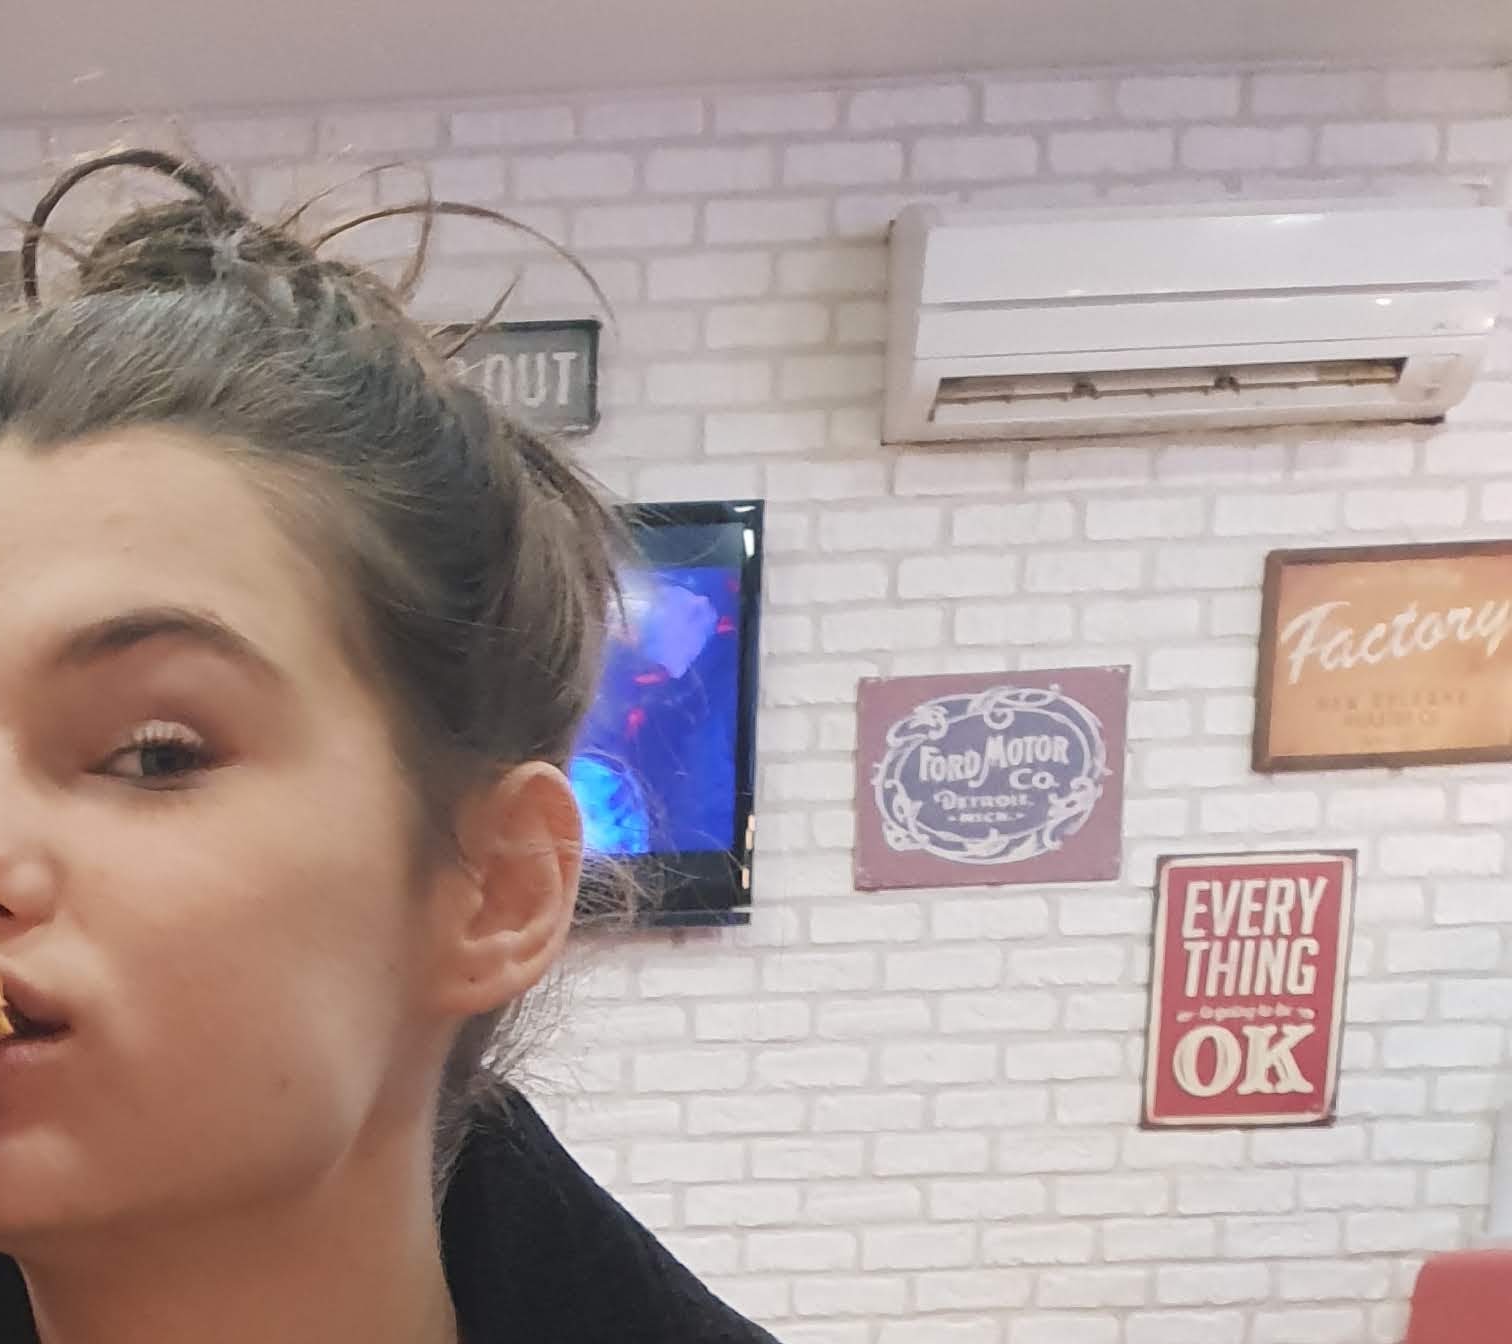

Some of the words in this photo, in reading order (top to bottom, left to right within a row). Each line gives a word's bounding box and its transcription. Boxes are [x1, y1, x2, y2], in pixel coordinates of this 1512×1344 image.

[484, 351, 579, 407] OUT
[1280, 599, 1511, 685] Factory
[982, 735, 1070, 772] MOTOR
[1182, 876, 1328, 938] EVERY
[1183, 938, 1320, 997] THING
[1172, 1024, 1315, 1097] OK
